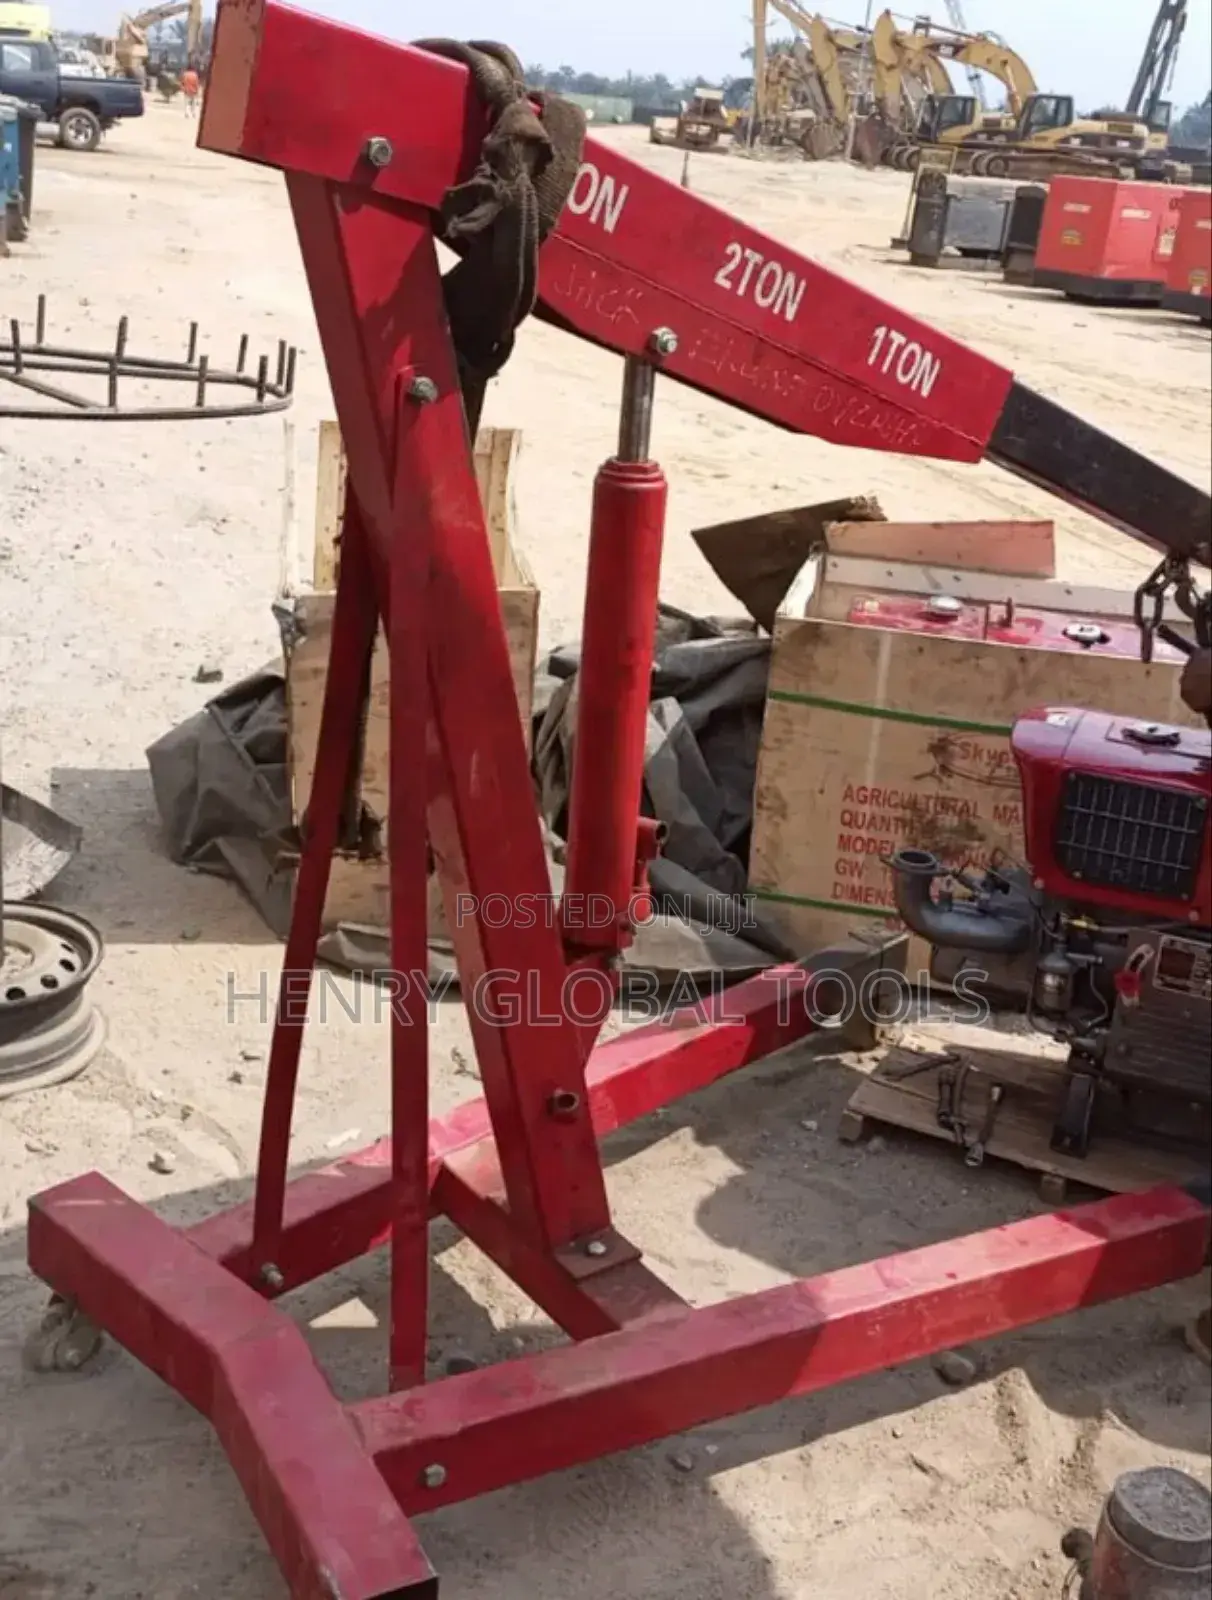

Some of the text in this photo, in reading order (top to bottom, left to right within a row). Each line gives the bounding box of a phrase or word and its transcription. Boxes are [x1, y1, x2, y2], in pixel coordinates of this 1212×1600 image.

[566, 162, 630, 234] ON
[713, 241, 807, 322] 2TON
[866, 324, 942, 399] 1TON
[842, 784, 982, 820] AGRICULTURAL
